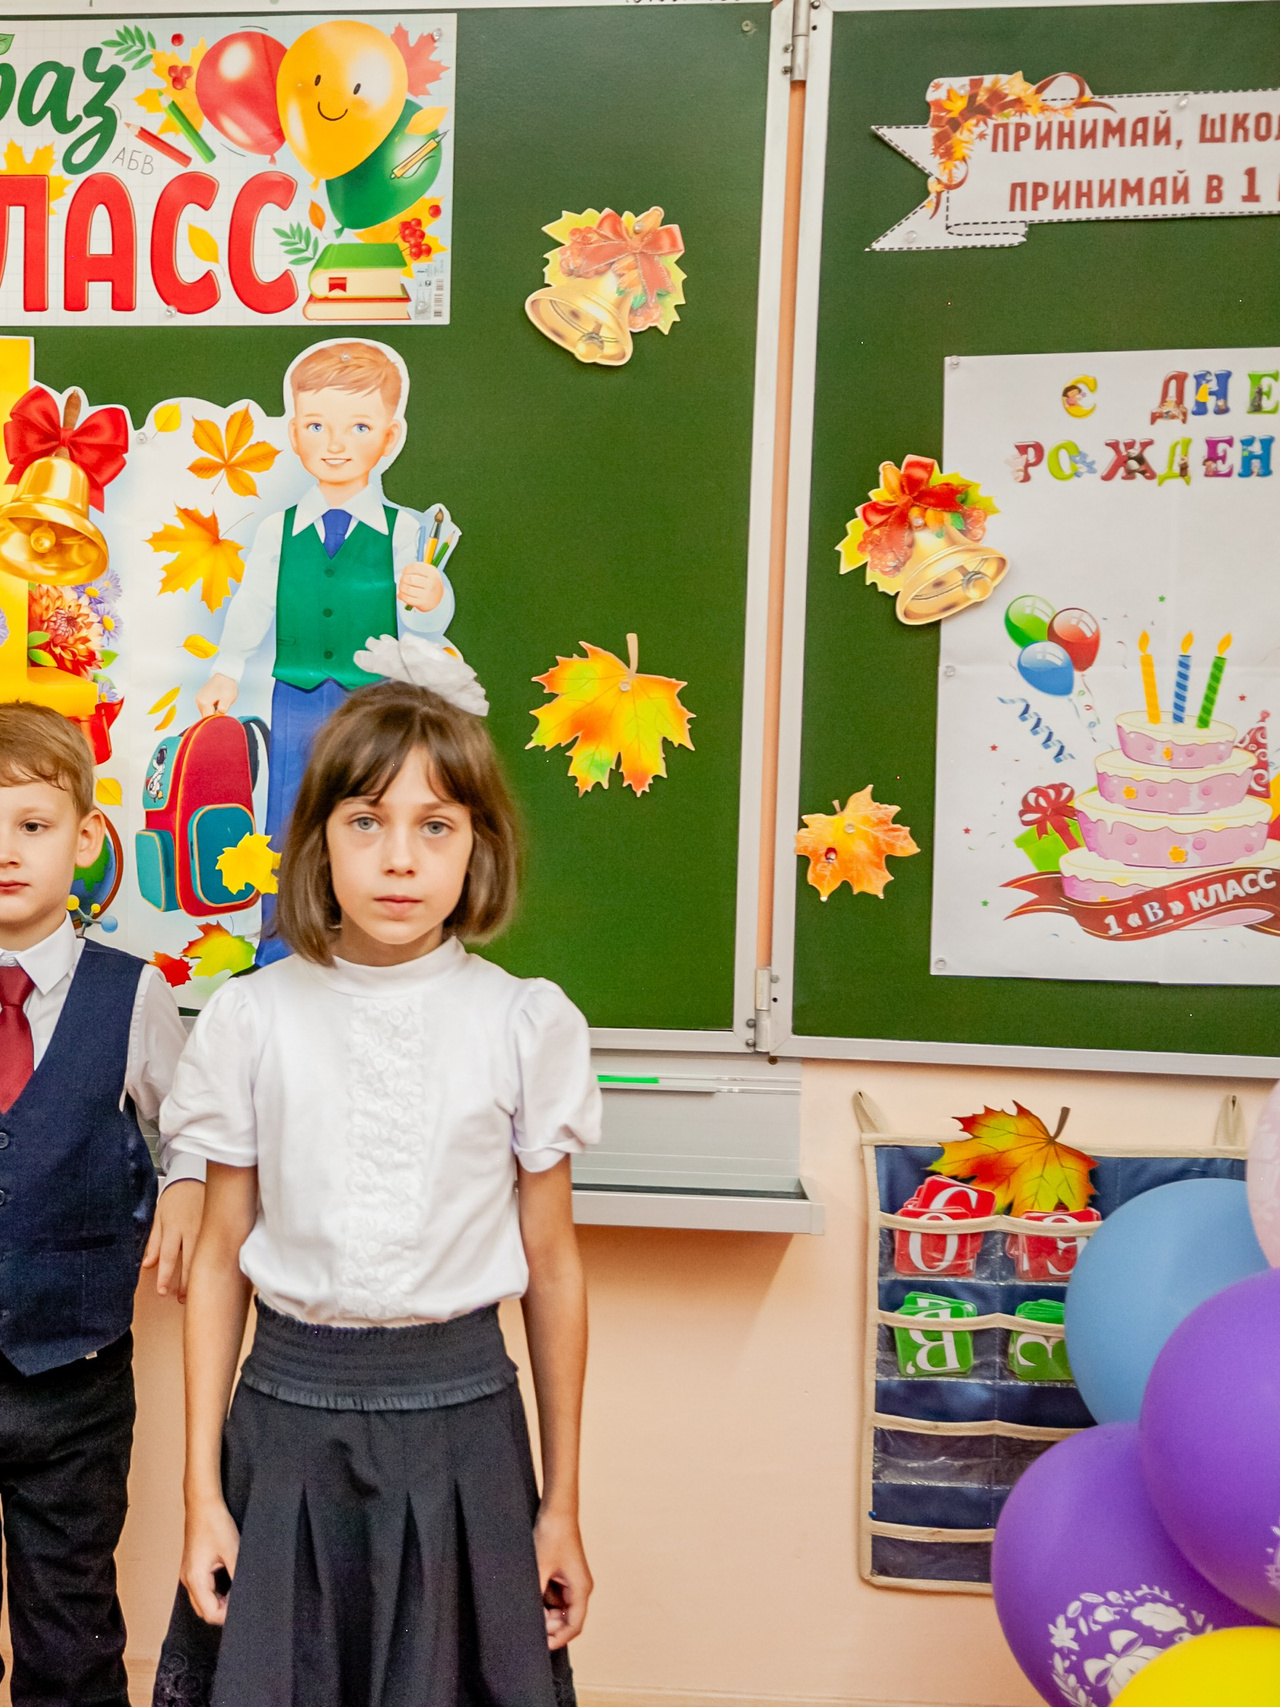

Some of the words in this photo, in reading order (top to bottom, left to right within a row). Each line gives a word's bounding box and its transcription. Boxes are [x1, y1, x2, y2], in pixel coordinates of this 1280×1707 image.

[991, 110, 1183, 152] ПРИНИМАЙ,
[111, 146, 154, 175] АБВ
[1008, 169, 1190, 212] ПРИНИМАЙ
[1205, 174, 1224, 204] В
[1241, 166, 1262, 203] 1
[1061, 374, 1098, 419] С
[1150, 369, 1280, 426] ДНЕ
[1005, 434, 1276, 487] РОЖДЕН
[1104, 914, 1123, 936] 1
[1187, 869, 1277, 911] КЛАСС
